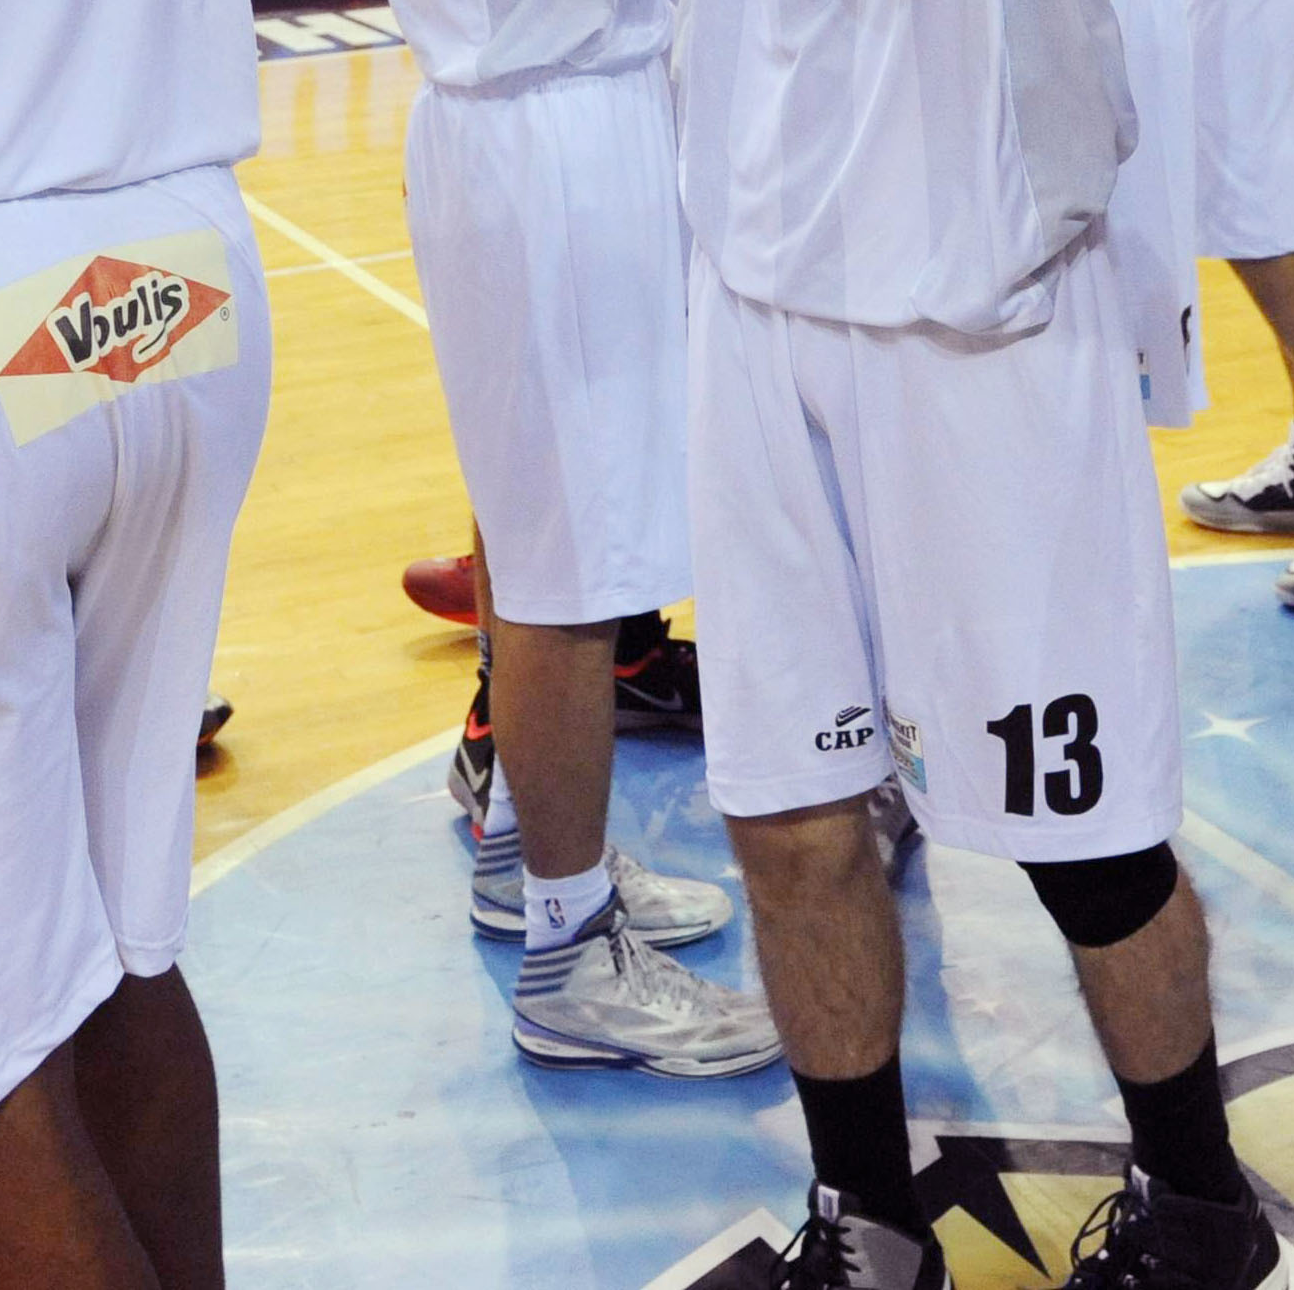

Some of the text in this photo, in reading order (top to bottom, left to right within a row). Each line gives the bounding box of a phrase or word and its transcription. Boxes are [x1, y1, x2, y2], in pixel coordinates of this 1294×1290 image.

[55, 279, 183, 363] Voulis
[814, 727, 875, 752] CAP
[986, 694, 1104, 817] 13
